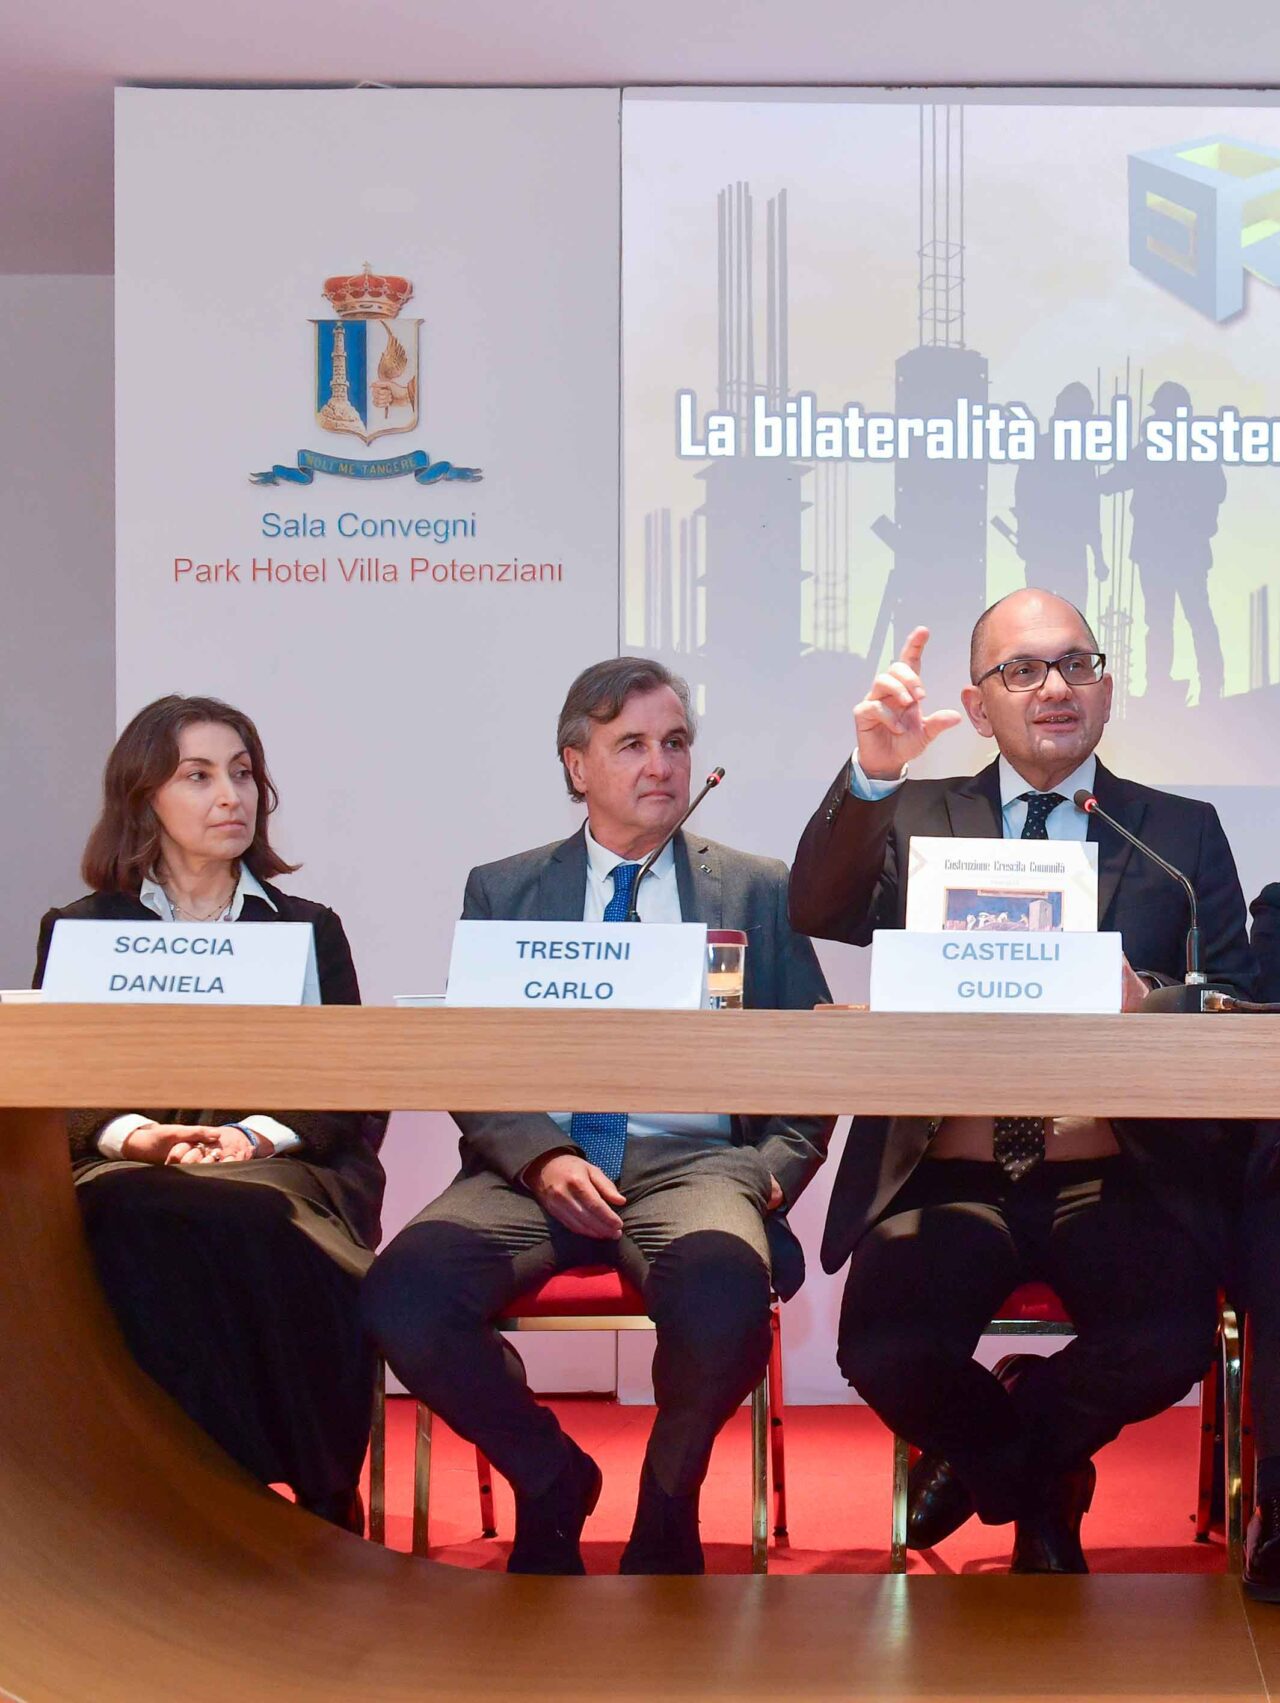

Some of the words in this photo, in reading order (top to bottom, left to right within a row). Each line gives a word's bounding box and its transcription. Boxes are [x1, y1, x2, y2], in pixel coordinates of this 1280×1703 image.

[679, 392, 737, 458] La
[753, 394, 1036, 461] bilateralità
[1052, 398, 1129, 462] nel
[261, 512, 327, 539] Sala
[336, 511, 477, 544] Convegni
[174, 557, 241, 583] Park
[252, 557, 327, 583] Hotel
[337, 557, 399, 583] Villa
[410, 557, 563, 583] Potenziani
[114, 936, 234, 956] SCACCIA
[515, 940, 630, 961] TRESTINI
[942, 942, 1060, 961] CASTELLI
[109, 974, 224, 994] DANIELA
[523, 980, 614, 1000] CARLO
[957, 980, 1043, 999] GUIDO
